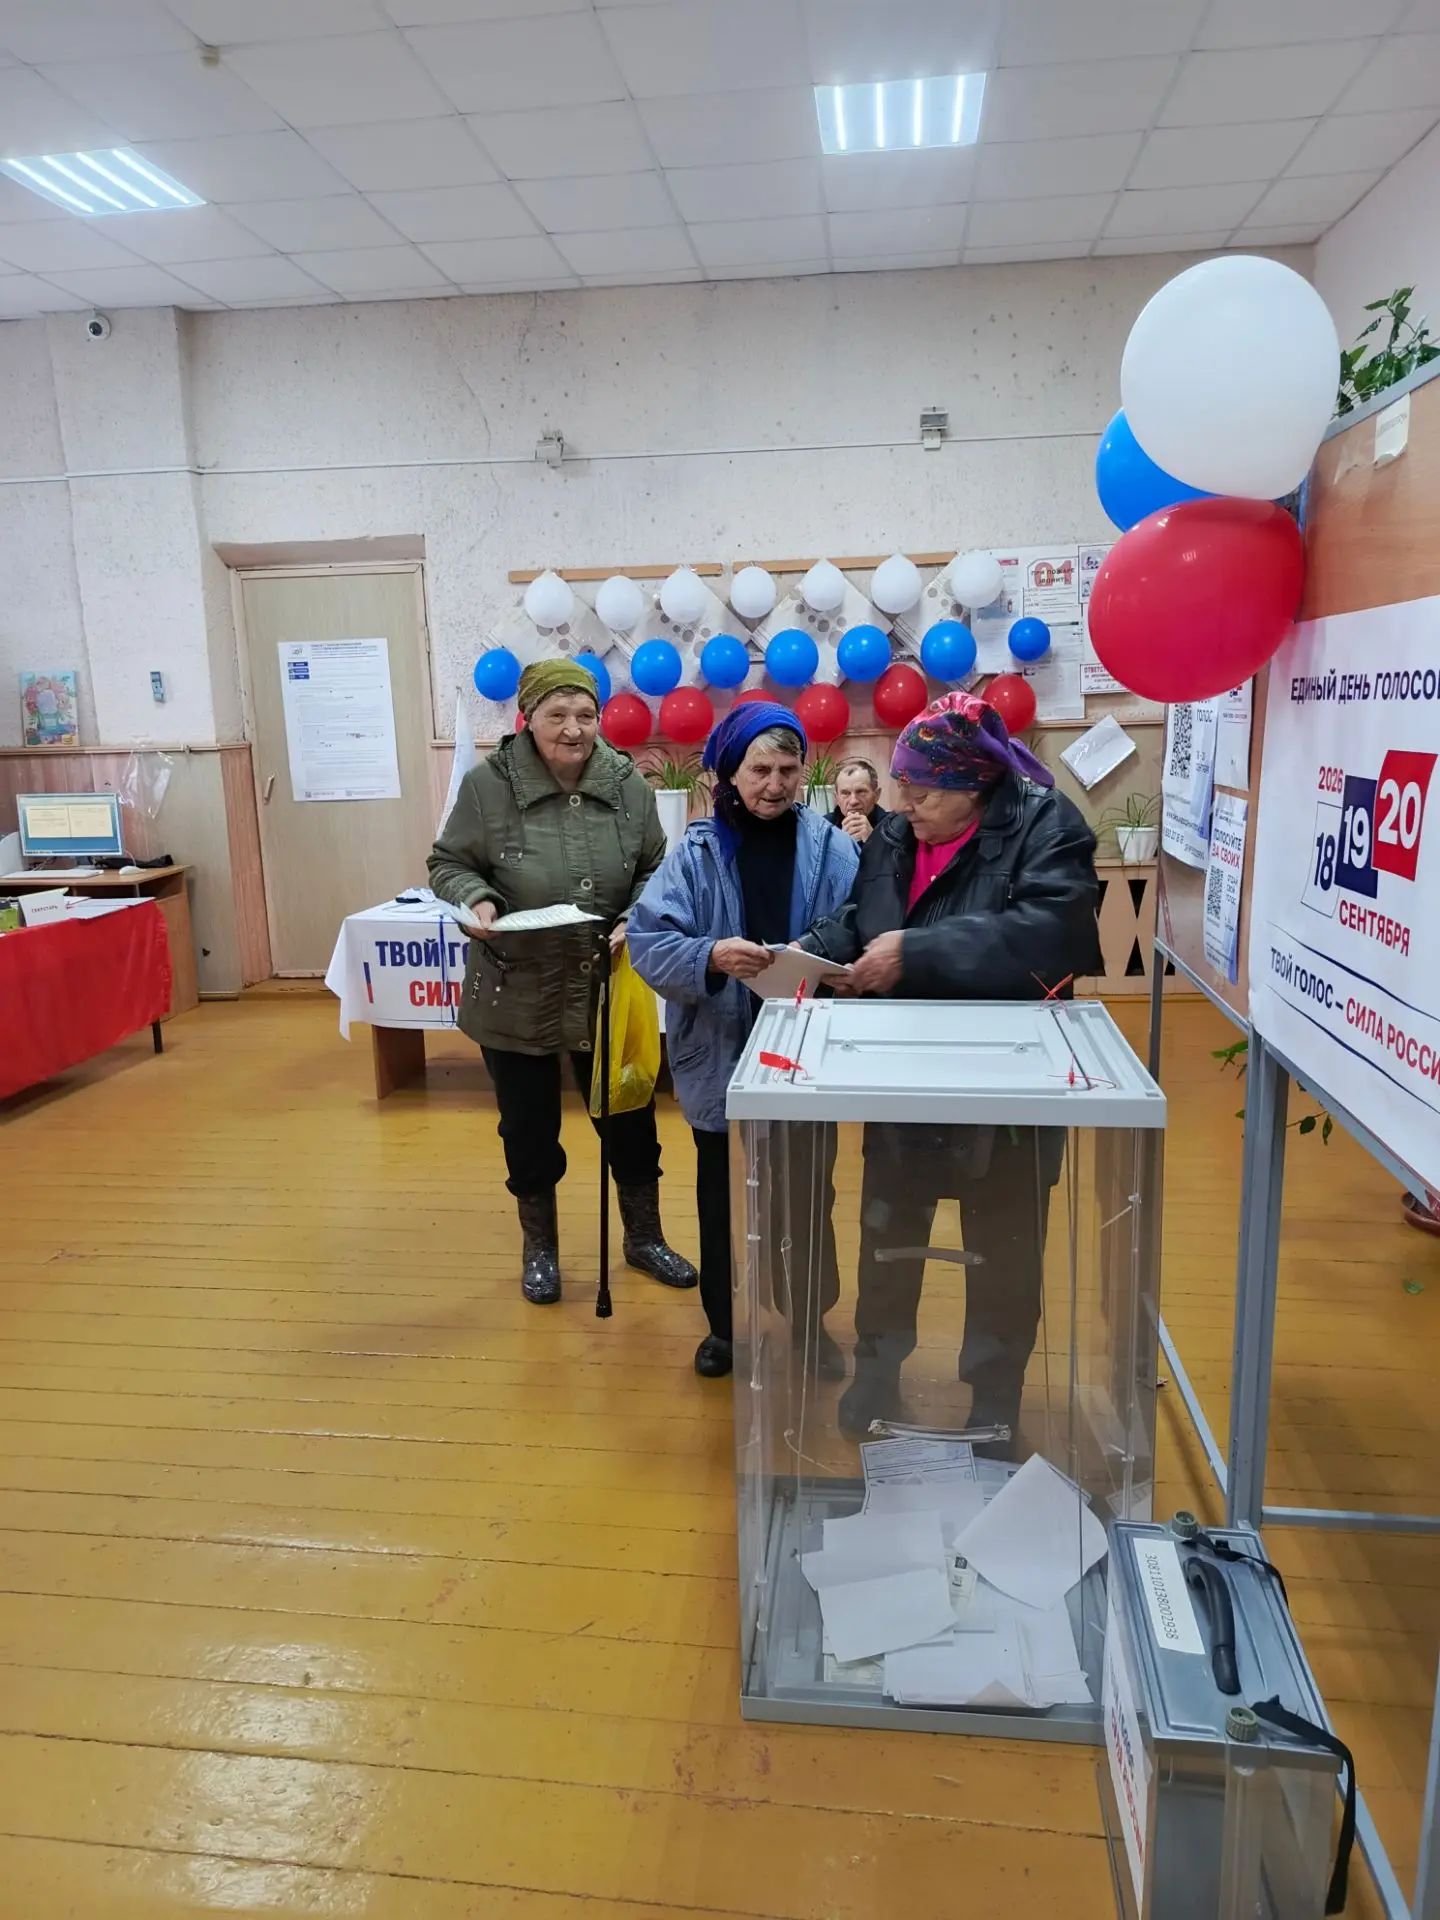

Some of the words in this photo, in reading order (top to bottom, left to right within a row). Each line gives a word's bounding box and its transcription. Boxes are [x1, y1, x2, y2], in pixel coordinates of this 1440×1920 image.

[1035, 560, 1072, 587] 01
[1291, 669, 1337, 704] ЕДИНЫЙ
[1338, 673, 1370, 704] ДЕНЬ
[1373, 669, 1440, 700] ГОЛОСО
[1318, 766, 1343, 793] 2026
[1314, 832, 1335, 891] 18
[1343, 804, 1370, 869] 19
[1378, 779, 1421, 849] 20
[1220, 847, 1240, 869] СВОИХ
[1339, 900, 1410, 957] СЕНТЯБРЯ
[375, 938, 440, 967] ТВОЙ
[1271, 947, 1293, 984] ТВОЙ
[1294, 965, 1333, 1009] ГОЛОС
[1346, 998, 1384, 1045] СИЛА
